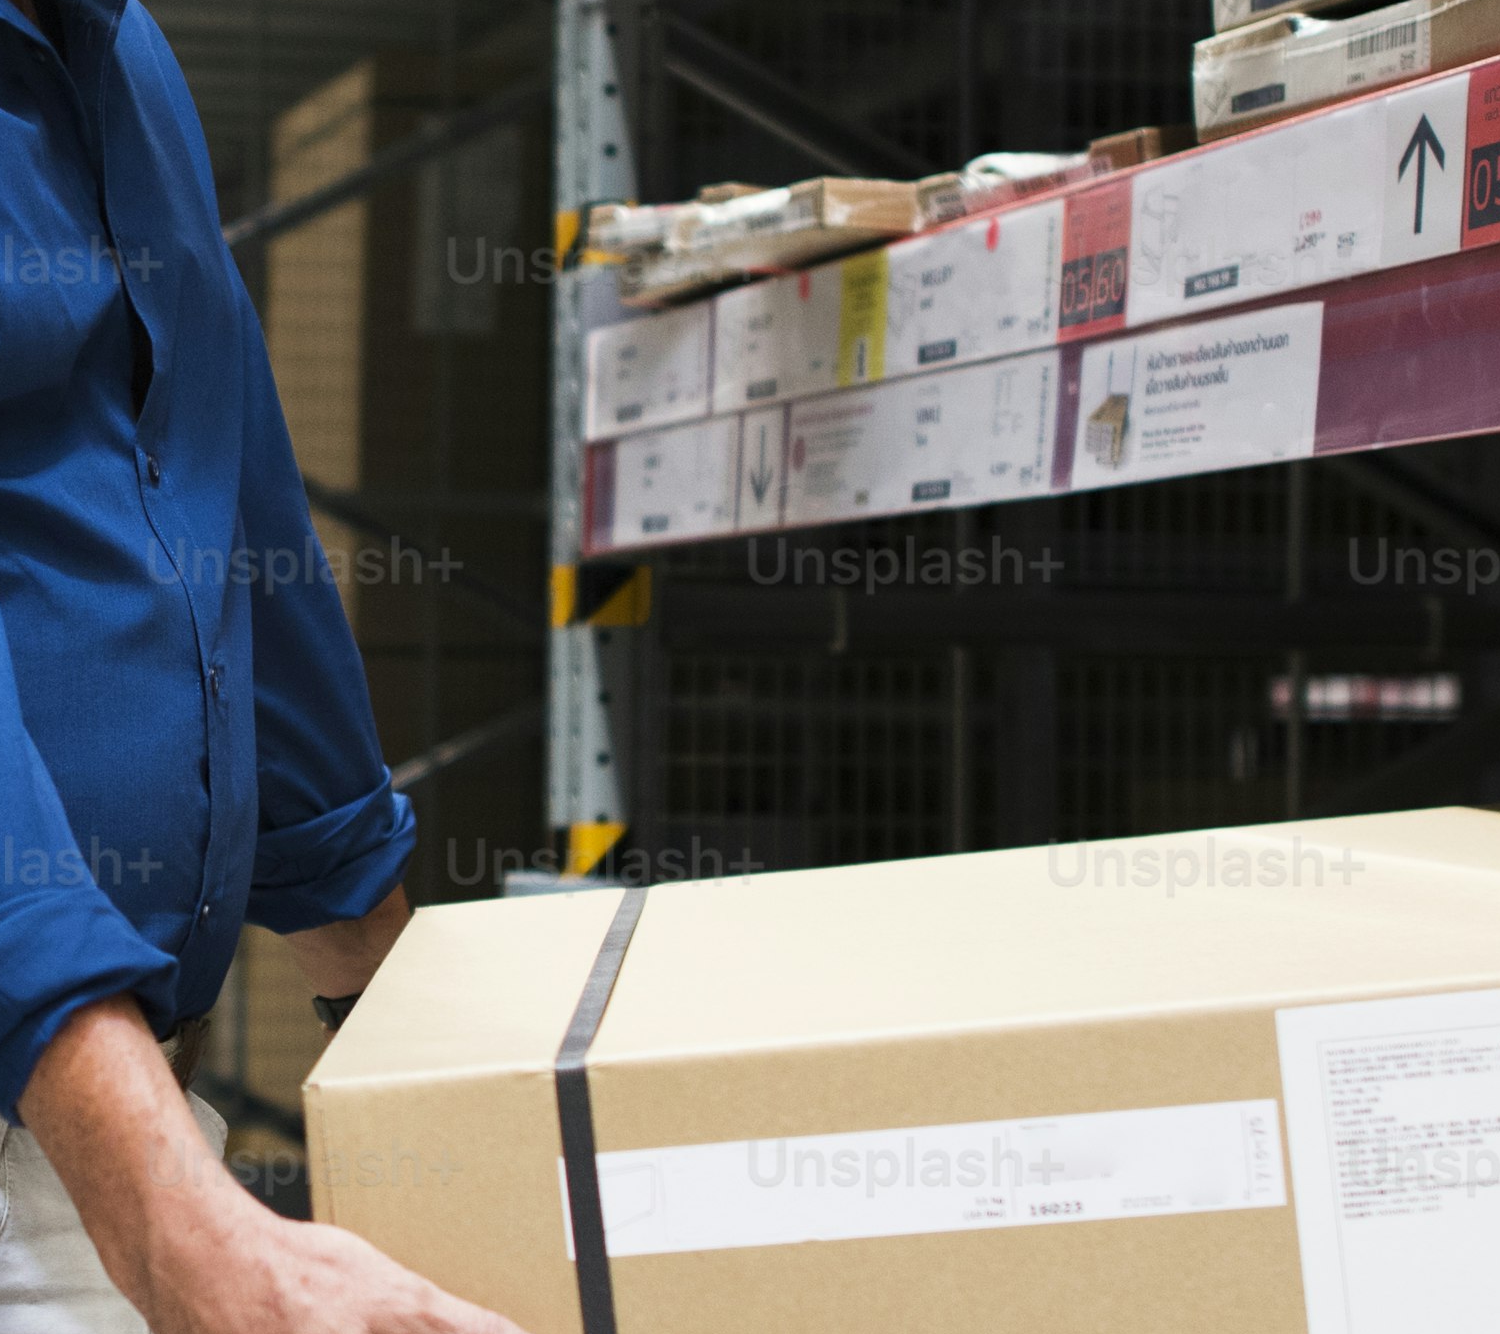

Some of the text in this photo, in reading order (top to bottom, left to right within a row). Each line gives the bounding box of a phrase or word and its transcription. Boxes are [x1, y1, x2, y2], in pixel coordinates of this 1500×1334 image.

[1062, 260, 1126, 316] 05 60
[1029, 1200, 1083, 1217] 16023
